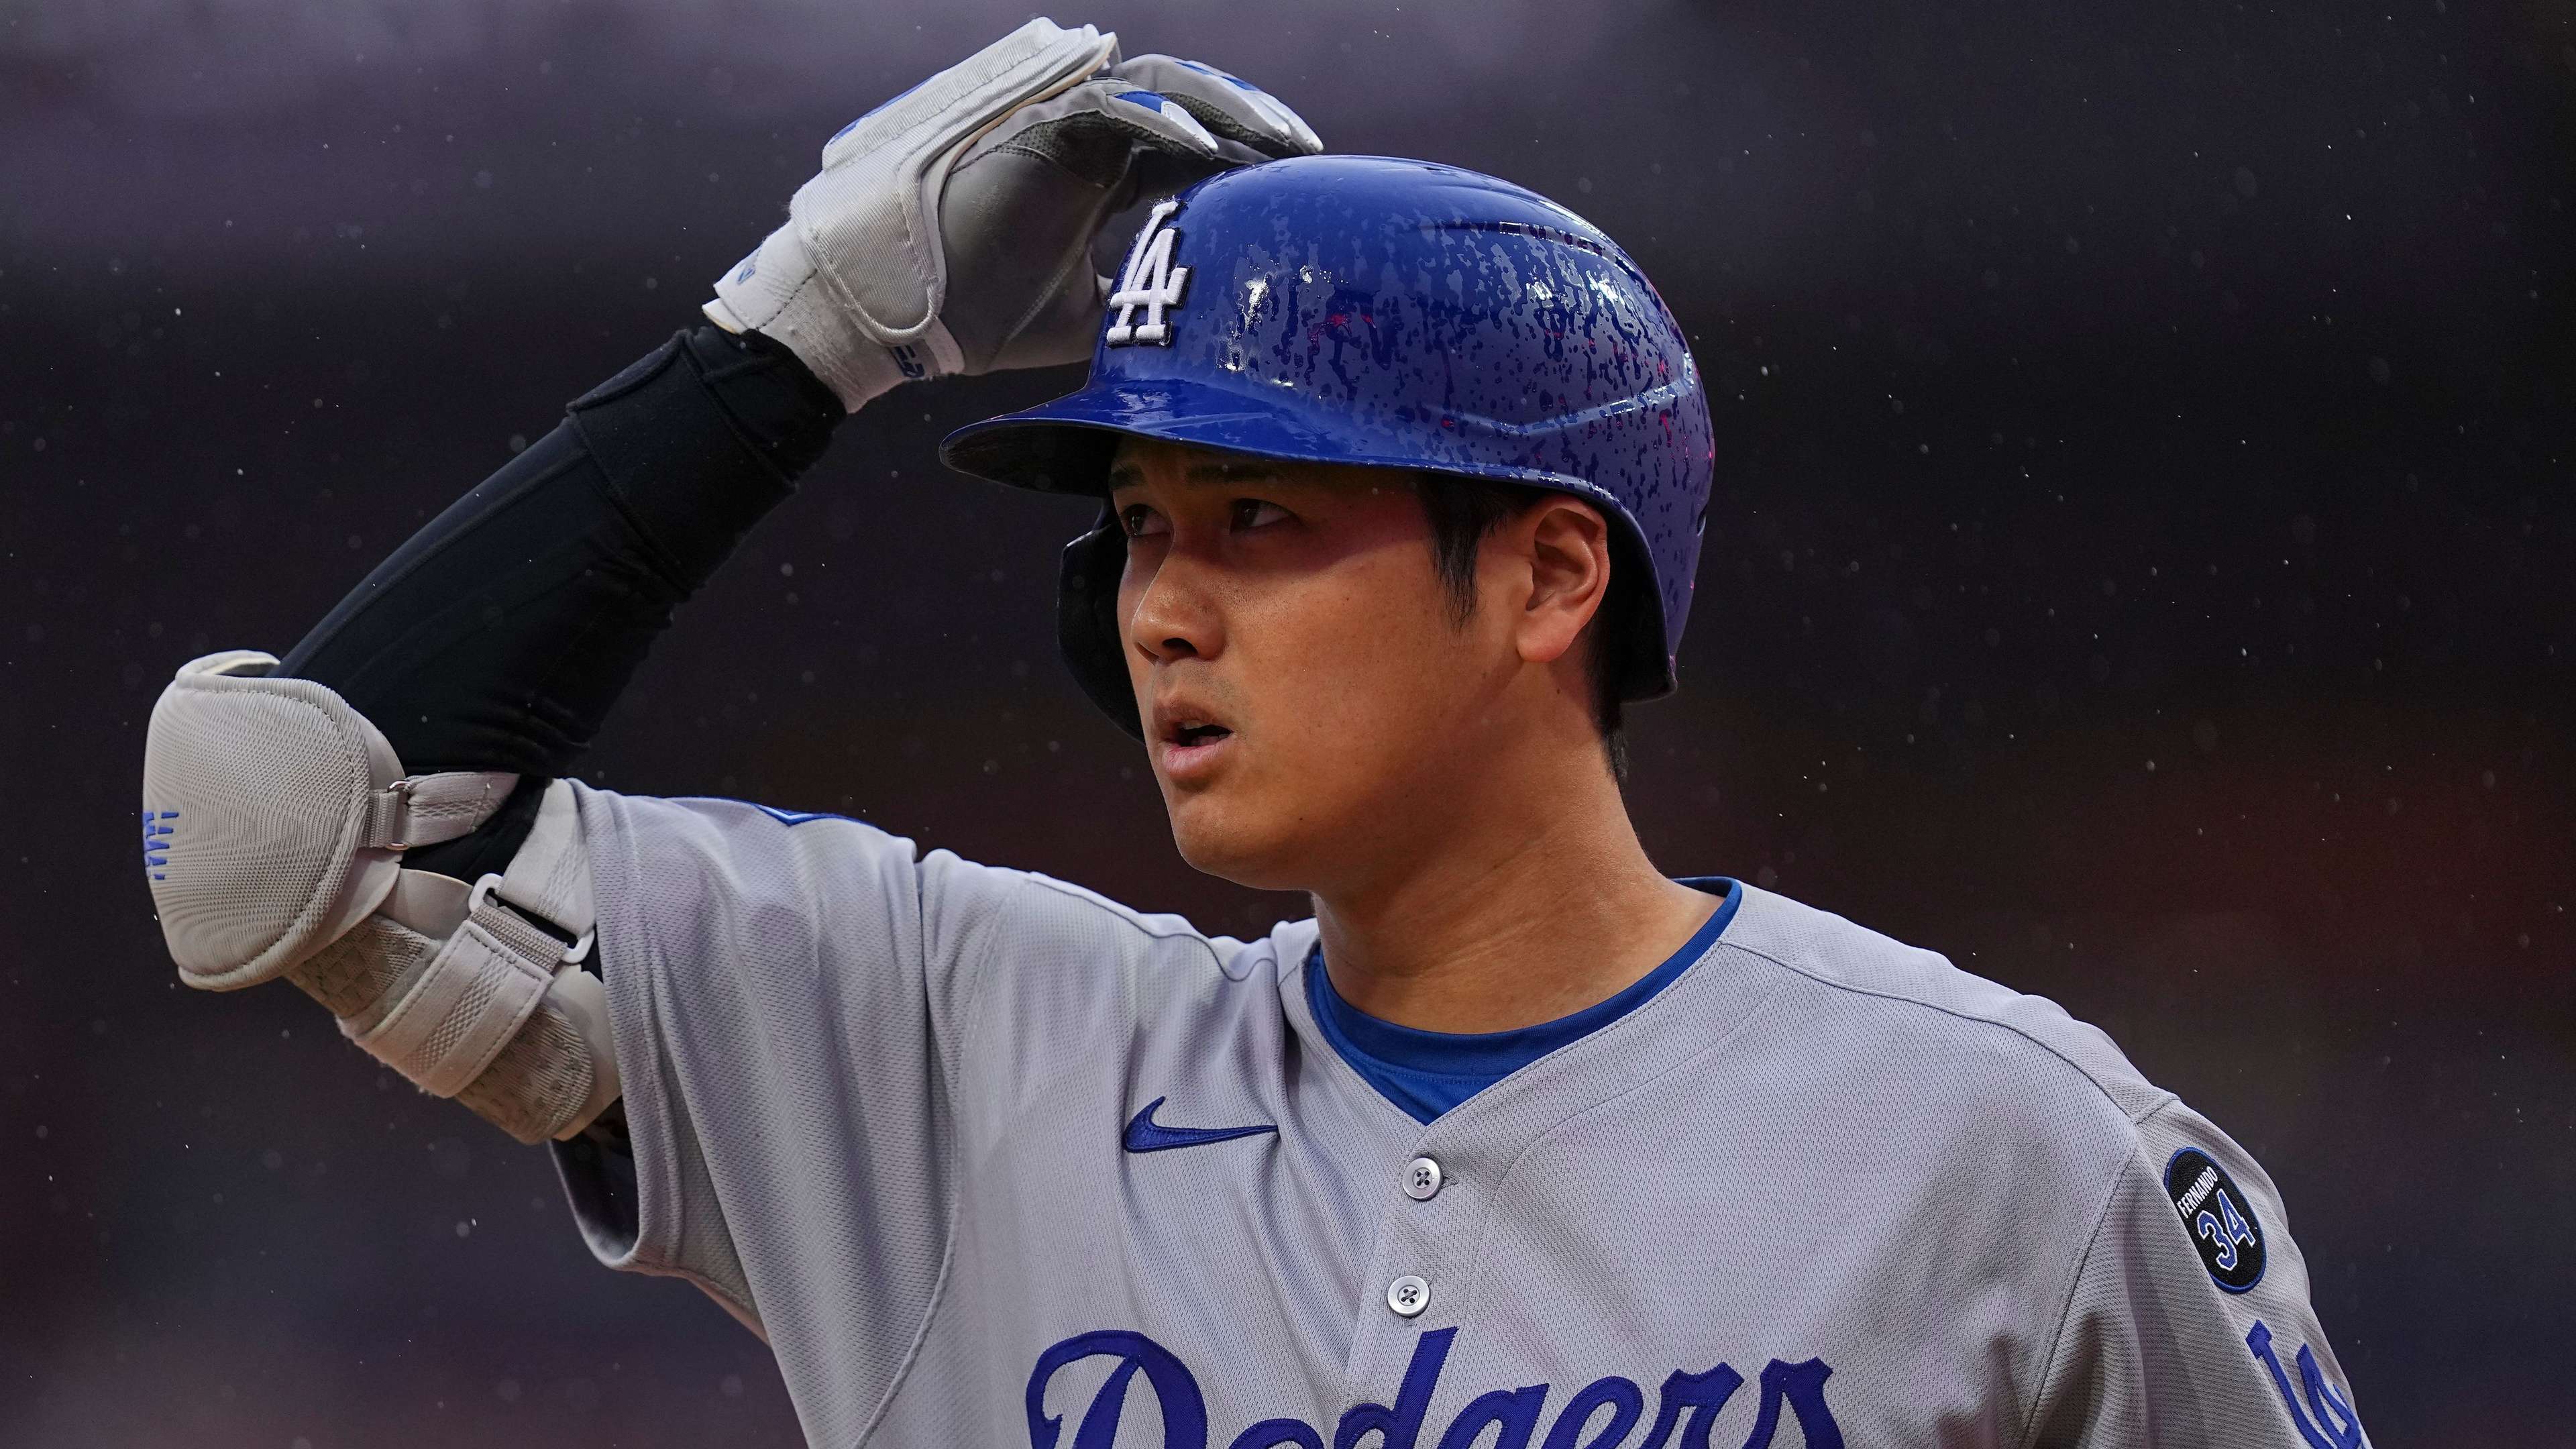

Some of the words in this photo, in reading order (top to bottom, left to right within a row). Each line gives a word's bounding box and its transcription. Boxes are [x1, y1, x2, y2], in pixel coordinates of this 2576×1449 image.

[1107, 201, 1187, 343] LA
[2177, 1166, 2218, 1218] FERNANDO
[2196, 1188, 2256, 1271] 34
